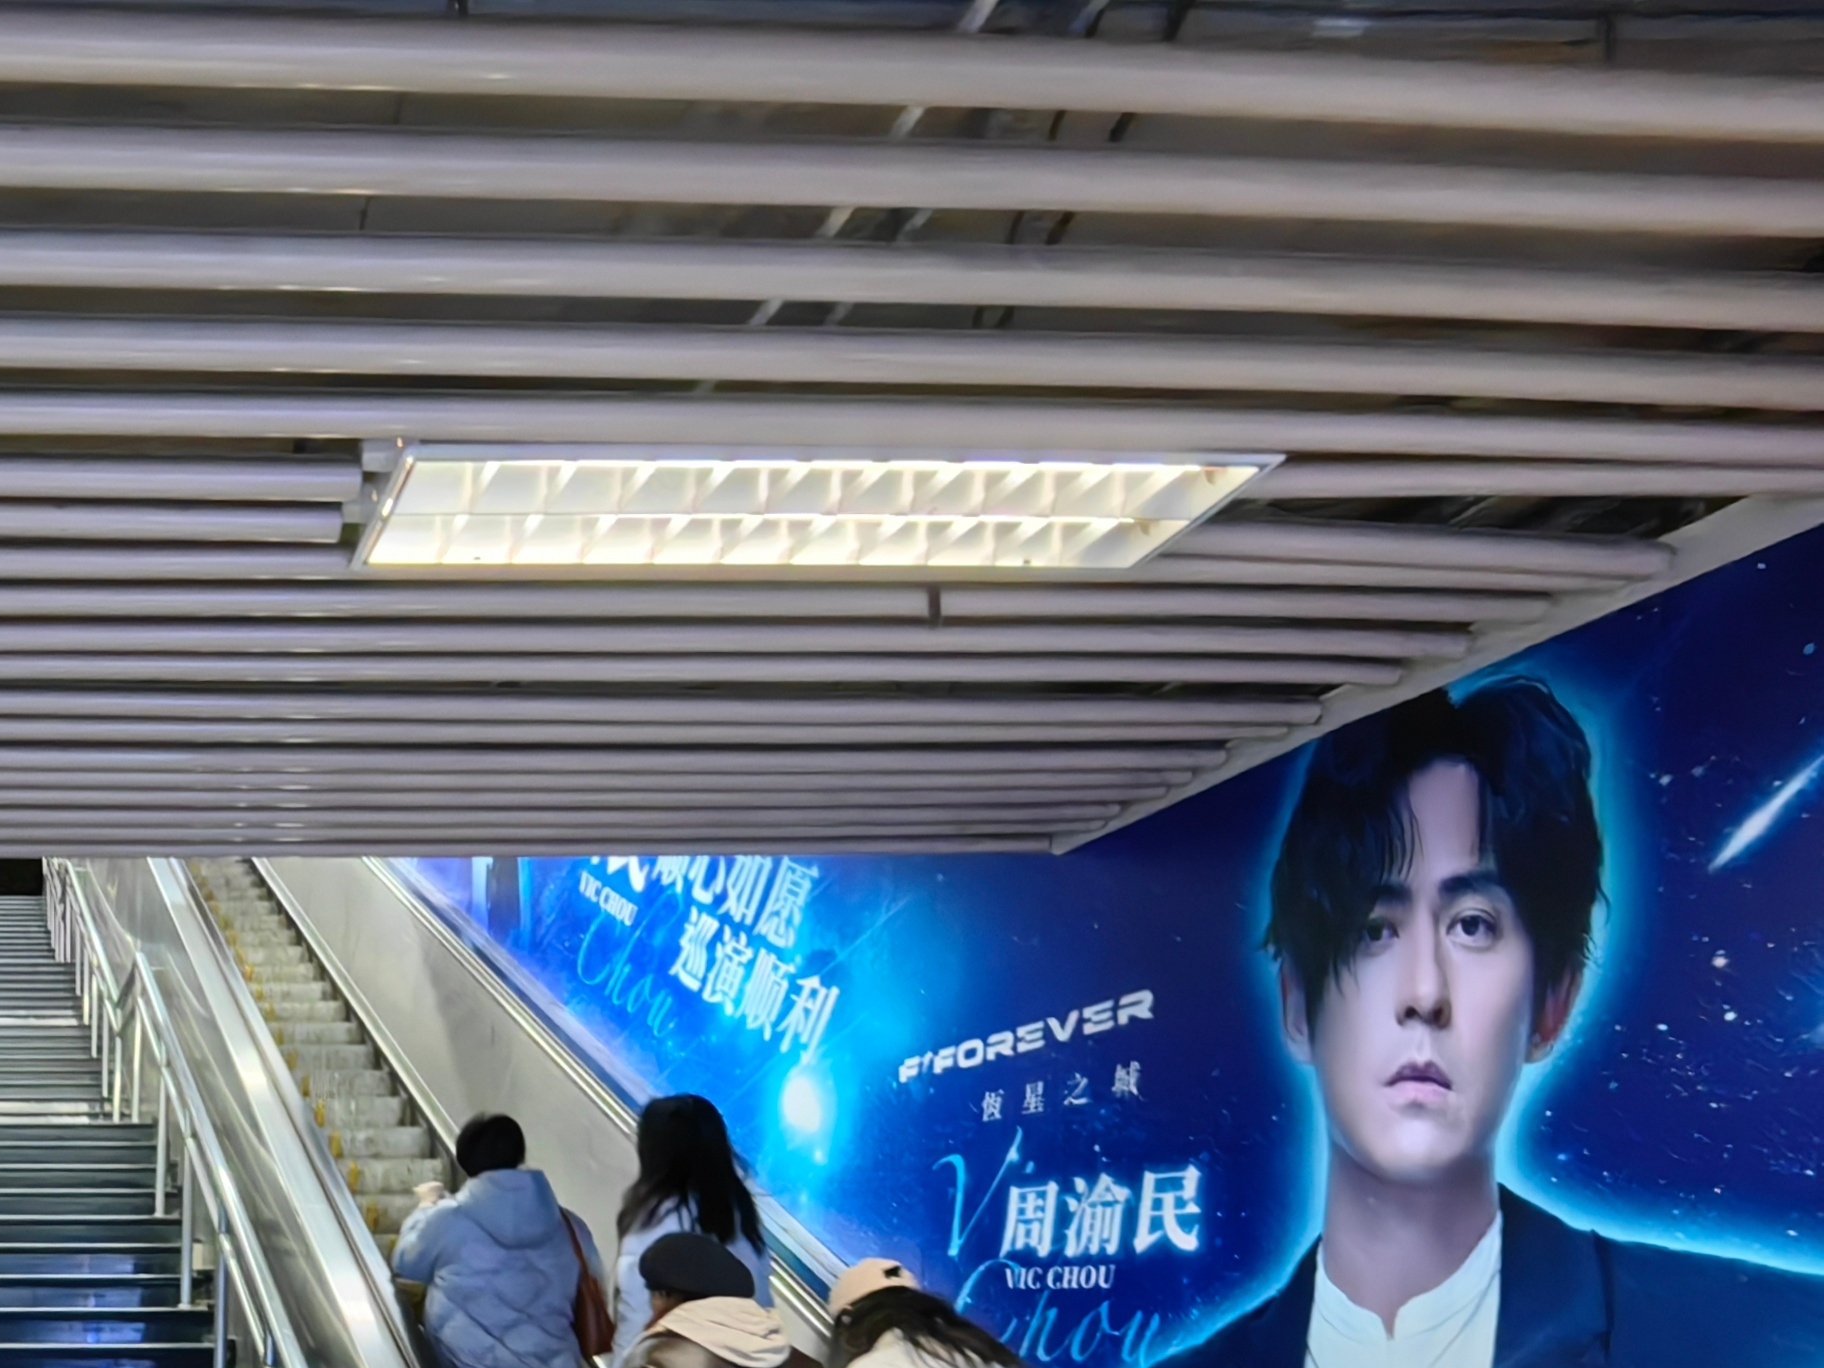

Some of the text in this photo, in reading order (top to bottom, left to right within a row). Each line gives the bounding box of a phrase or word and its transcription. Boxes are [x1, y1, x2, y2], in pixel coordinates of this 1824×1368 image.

[668, 905, 841, 1066] 巡演顺利
[998, 1163, 1202, 1259] 周渝民
[1004, 1264, 1117, 1290] VIC CHOU
